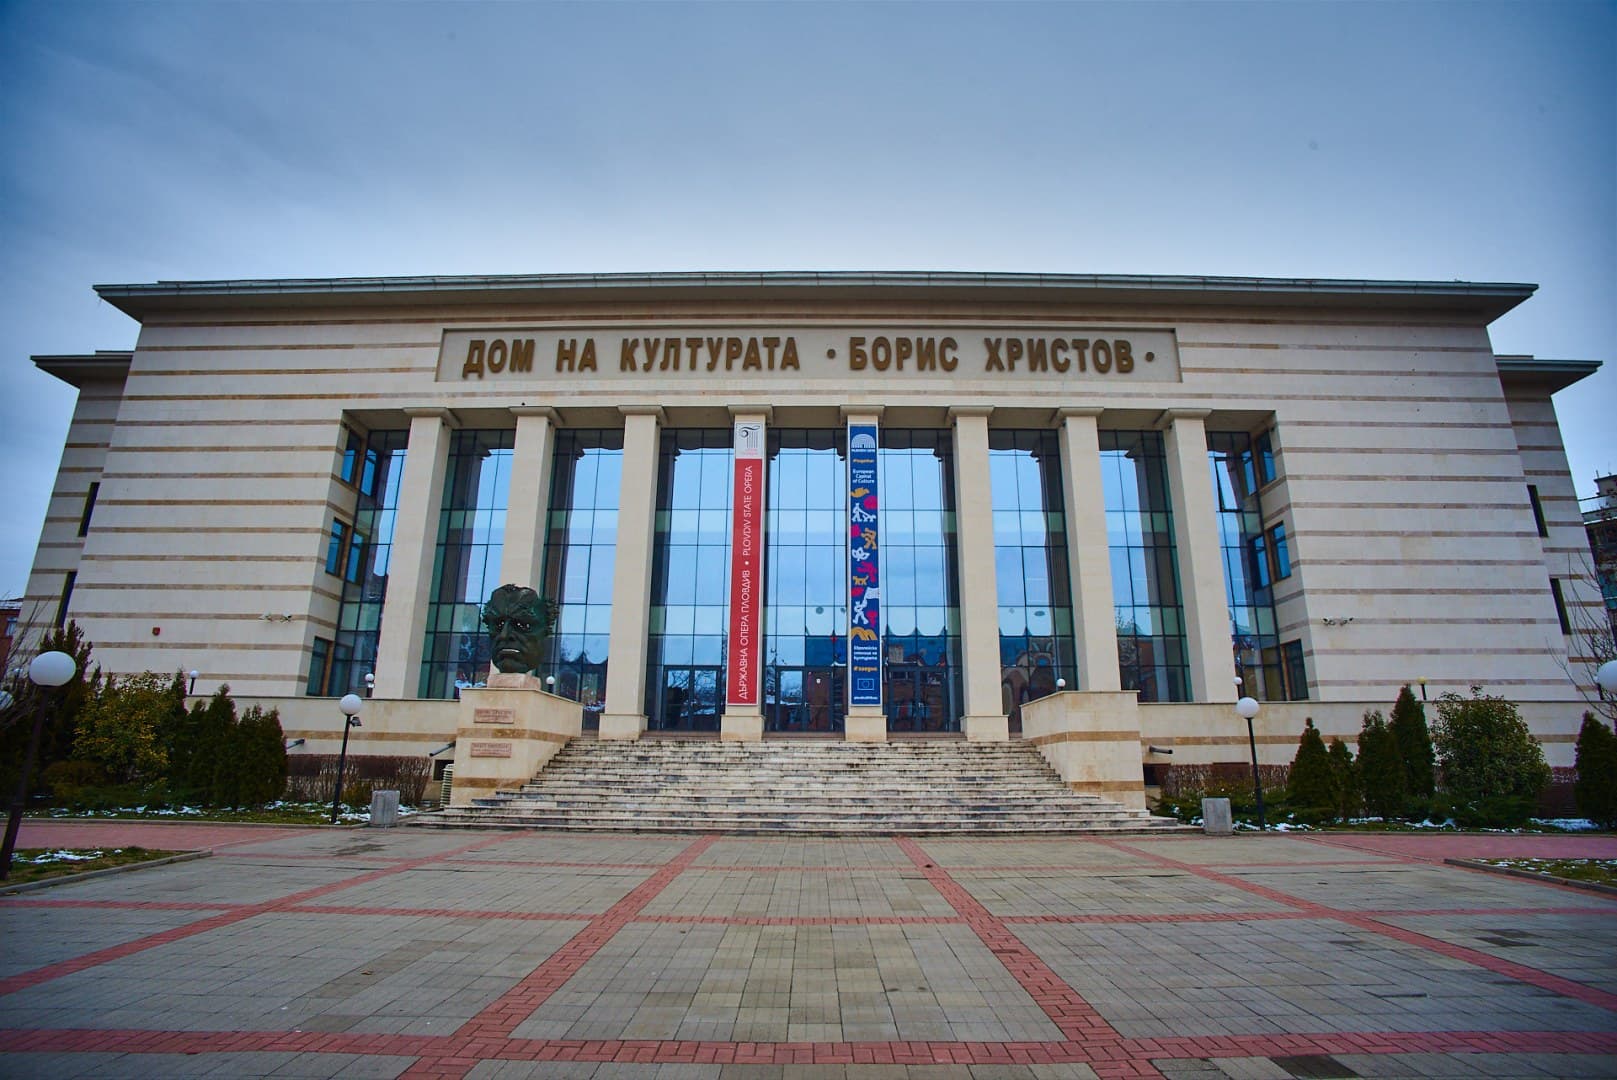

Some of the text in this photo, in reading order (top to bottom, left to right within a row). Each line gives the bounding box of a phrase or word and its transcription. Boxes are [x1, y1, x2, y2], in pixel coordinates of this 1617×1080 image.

[463, 336, 1135, 379] ДОМ НА КУЛТУРАТА БОРИС ХРИСТОВ
[744, 465, 753, 494] OPERA
[743, 495, 752, 517] STATE
[742, 520, 752, 556] PLOVDIV
[738, 570, 751, 700] ДЪРЖАВНА ОПЕРА ПЛОВДИВ
